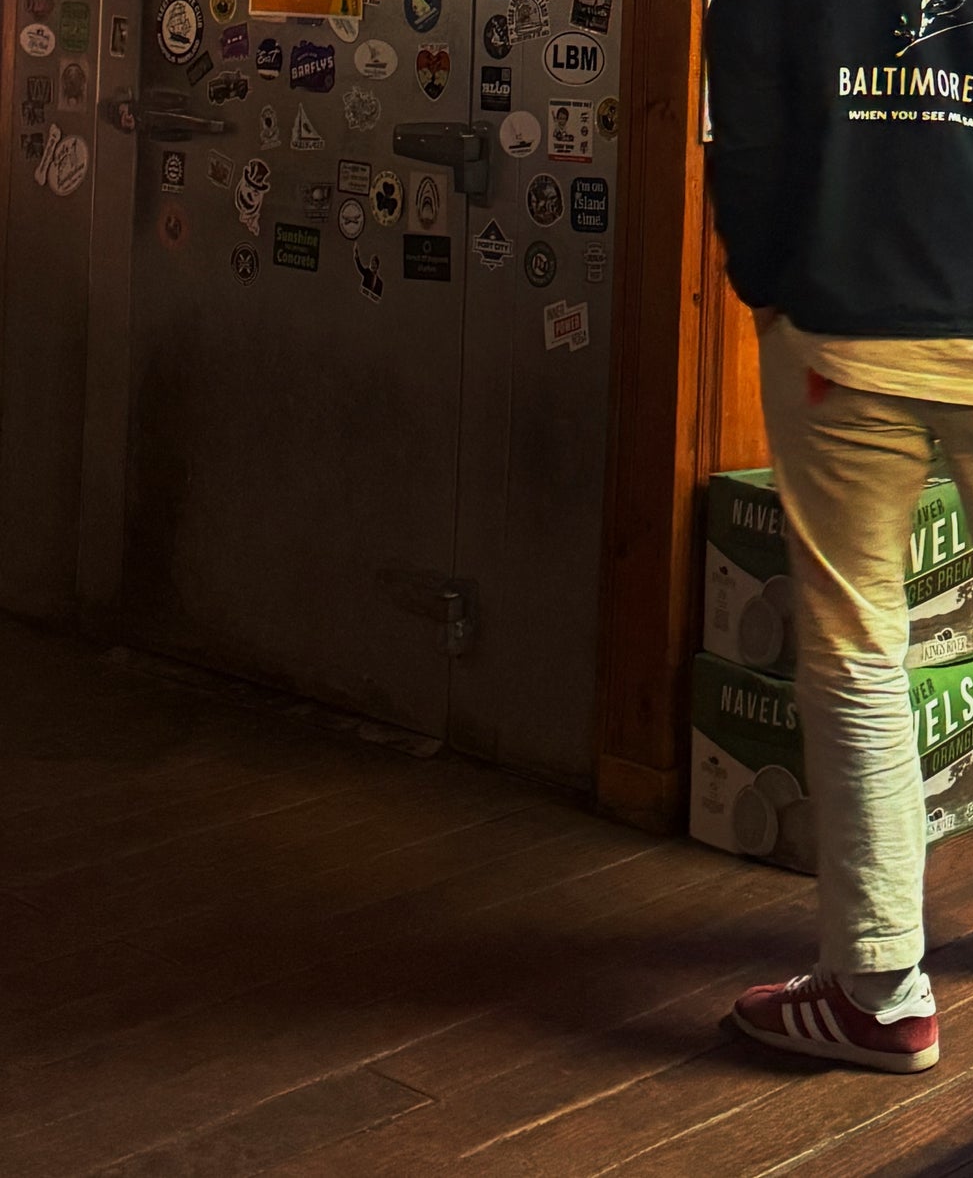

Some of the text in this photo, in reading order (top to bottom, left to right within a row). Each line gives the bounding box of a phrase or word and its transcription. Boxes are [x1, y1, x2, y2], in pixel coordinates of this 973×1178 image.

[291, 56, 334, 80] BARFLYS
[552, 44, 598, 72] LBM
[848, 110, 888, 121] WHEN
[891, 110, 918, 121] YOU
[922, 110, 946, 121] SEE
[576, 180, 604, 193] I'm on
[275, 225, 319, 247] Sunshine
[494, 243, 508, 251] CITY
[276, 249, 316, 270] Concrete
[732, 498, 786, 536] NAVEL
[916, 498, 945, 526] IVER
[909, 516, 966, 575] VEL
[945, 637, 966, 654] RIVER
[720, 685, 798, 731] NAVELS
